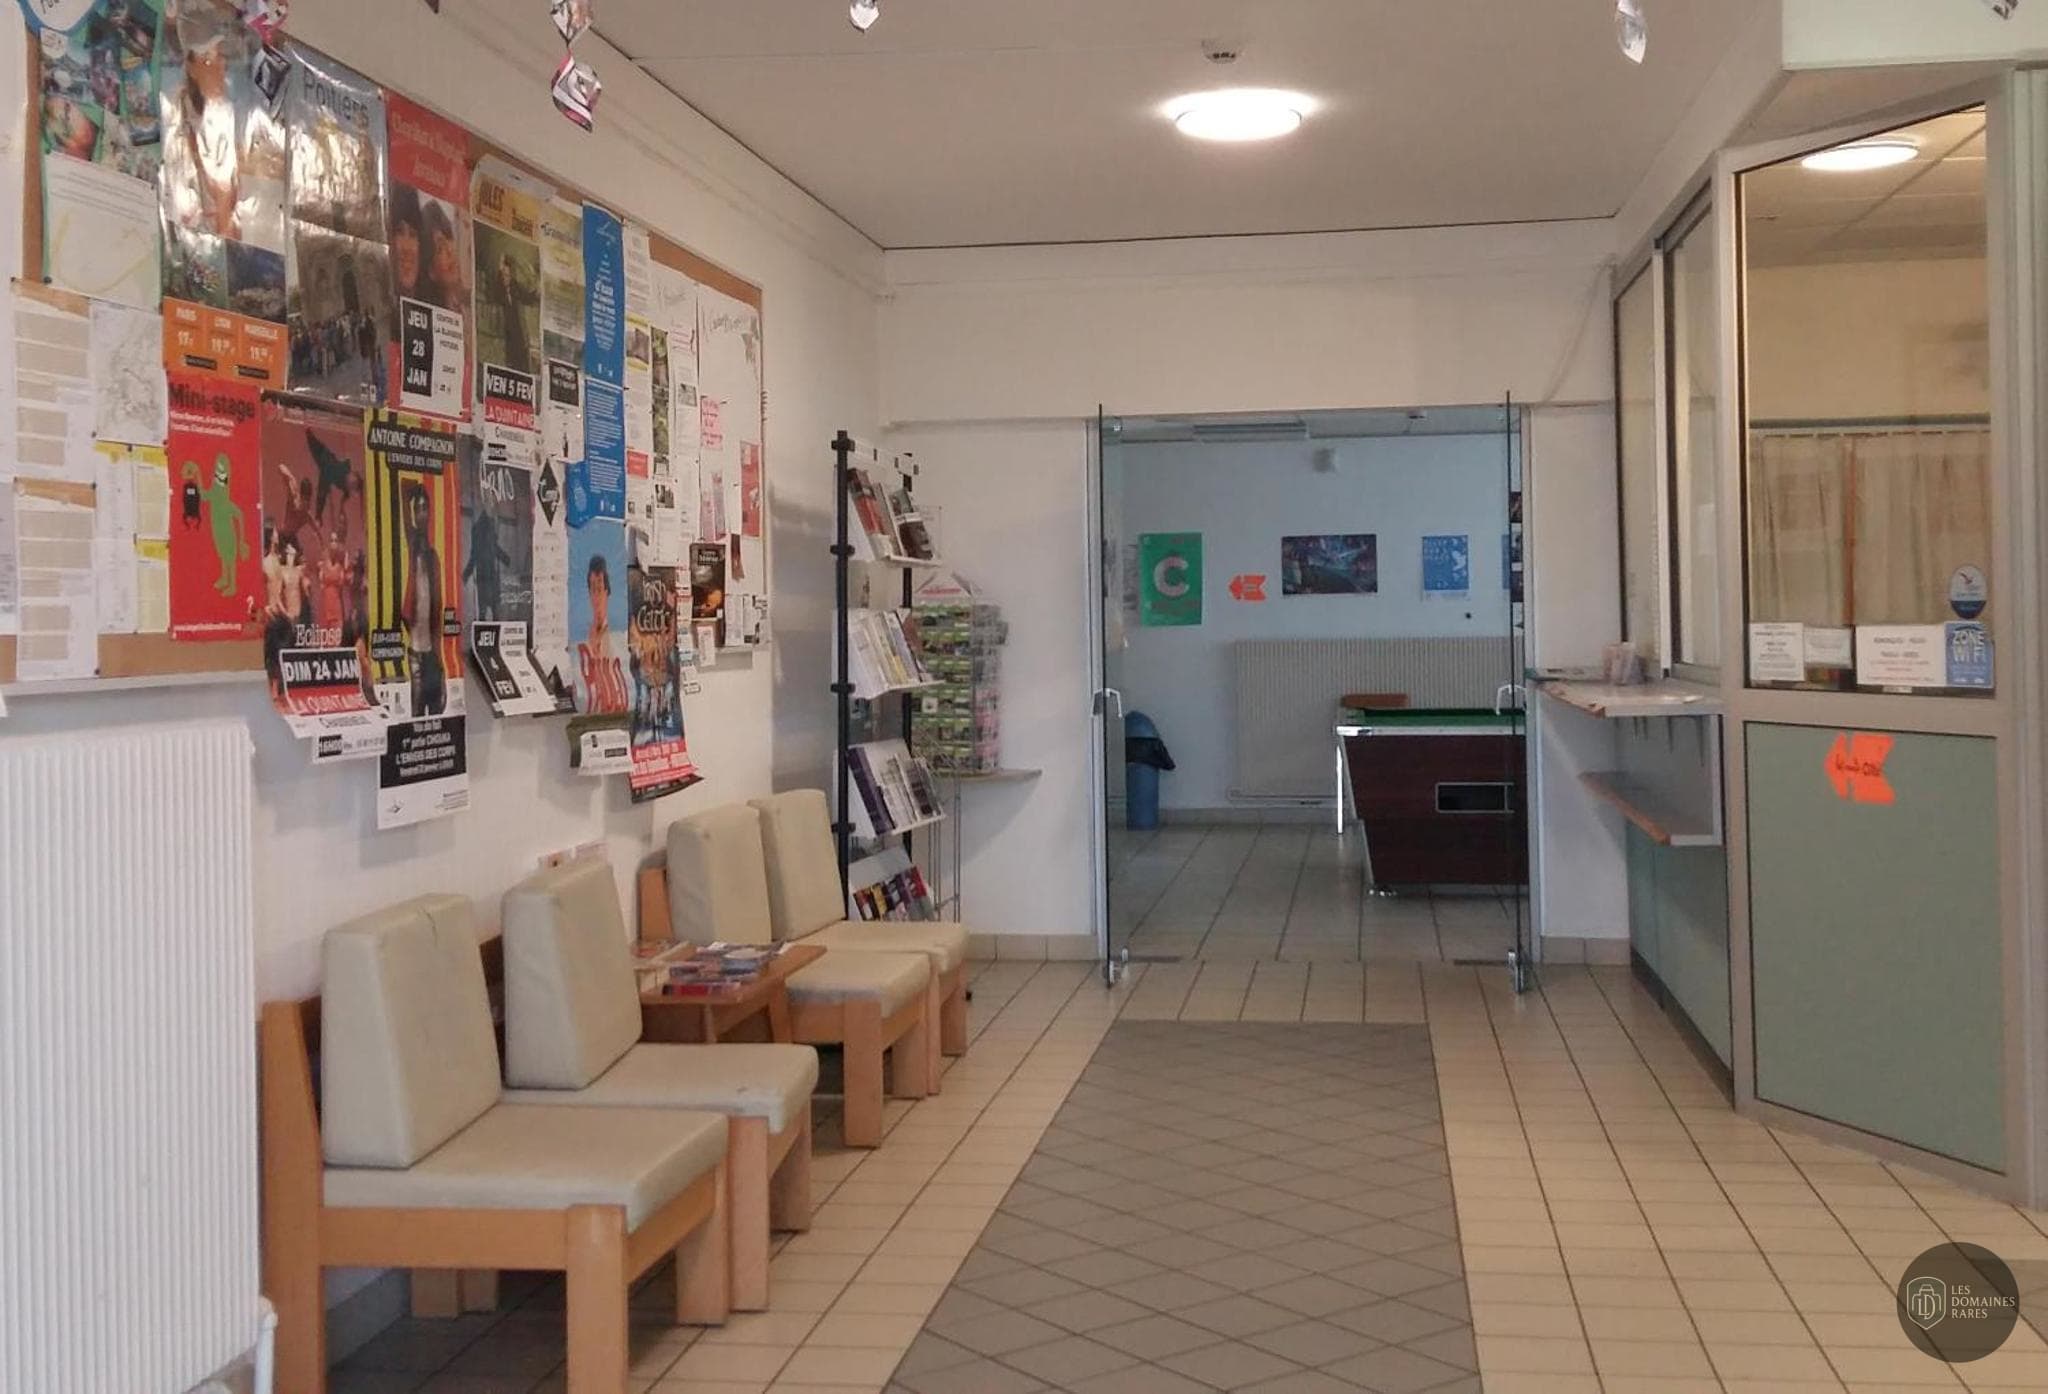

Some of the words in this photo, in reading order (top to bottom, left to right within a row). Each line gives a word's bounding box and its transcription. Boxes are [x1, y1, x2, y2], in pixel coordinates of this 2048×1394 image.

[407, 310, 428, 330] JEU
[412, 338, 426, 357] 28
[406, 366, 428, 387] JAN
[485, 373, 507, 395] VEN
[508, 378, 516, 397] 5
[370, 427, 406, 448] ANTOINE
[1153, 555, 1190, 598] C
[294, 623, 342, 650] Eclipse
[478, 630, 496, 647] JEU
[1953, 629, 1985, 646] ZONE
[284, 659, 312, 683] DIM
[313, 659, 331, 680] 24
[334, 658, 360, 679] JAN
